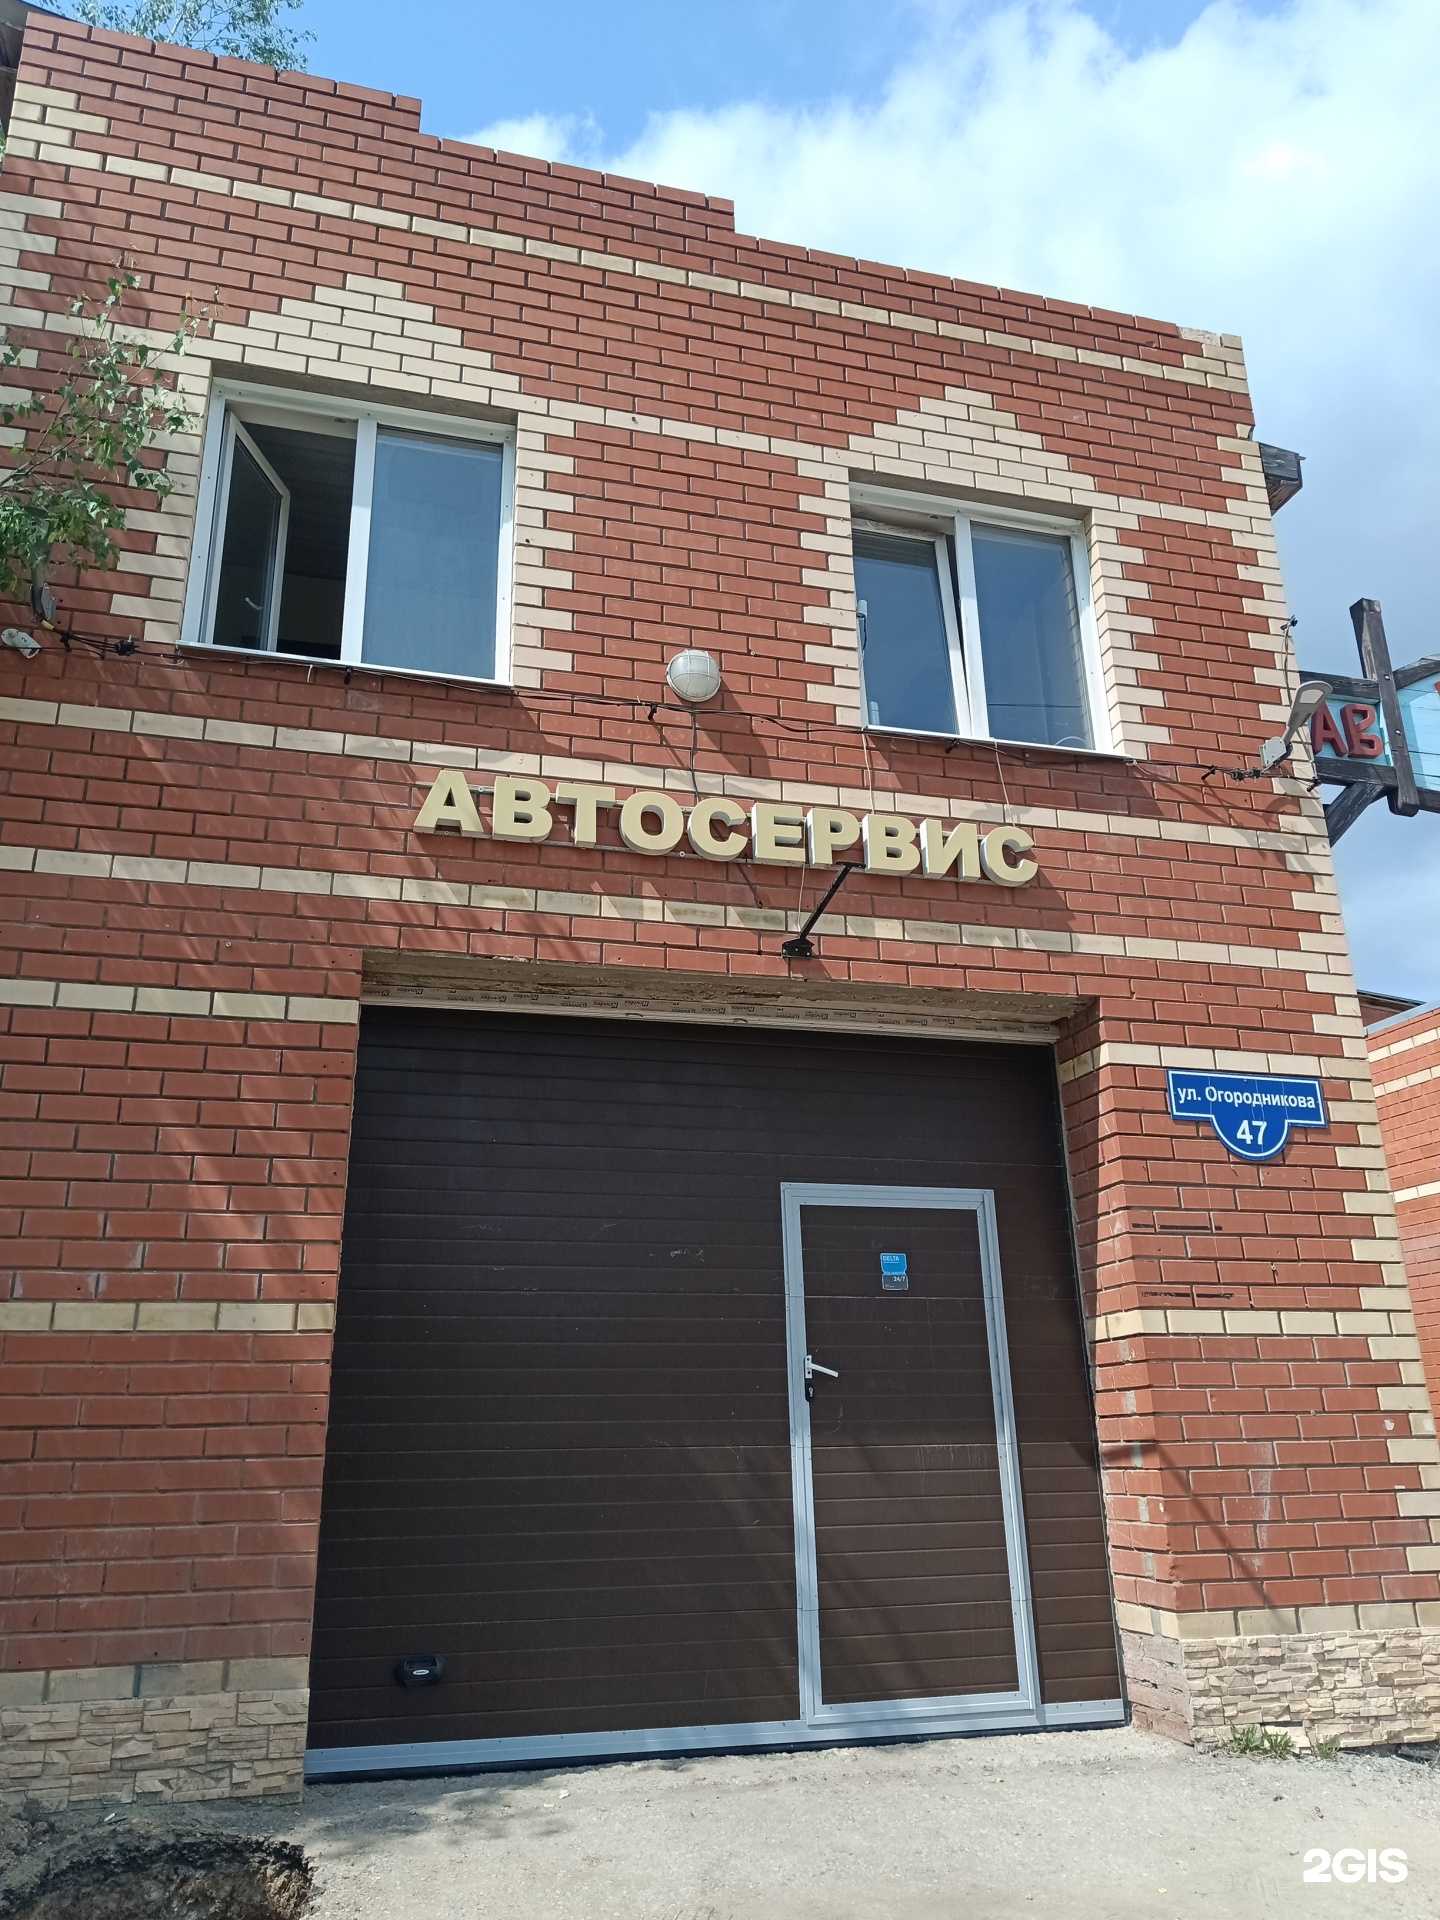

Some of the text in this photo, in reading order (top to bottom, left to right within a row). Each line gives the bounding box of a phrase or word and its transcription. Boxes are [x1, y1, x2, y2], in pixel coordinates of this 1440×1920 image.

[413, 769, 1039, 887] АВТОСЕРВИС
[1177, 1086, 1316, 1109] ул. Огородникова
[1236, 1119, 1268, 1145] 47
